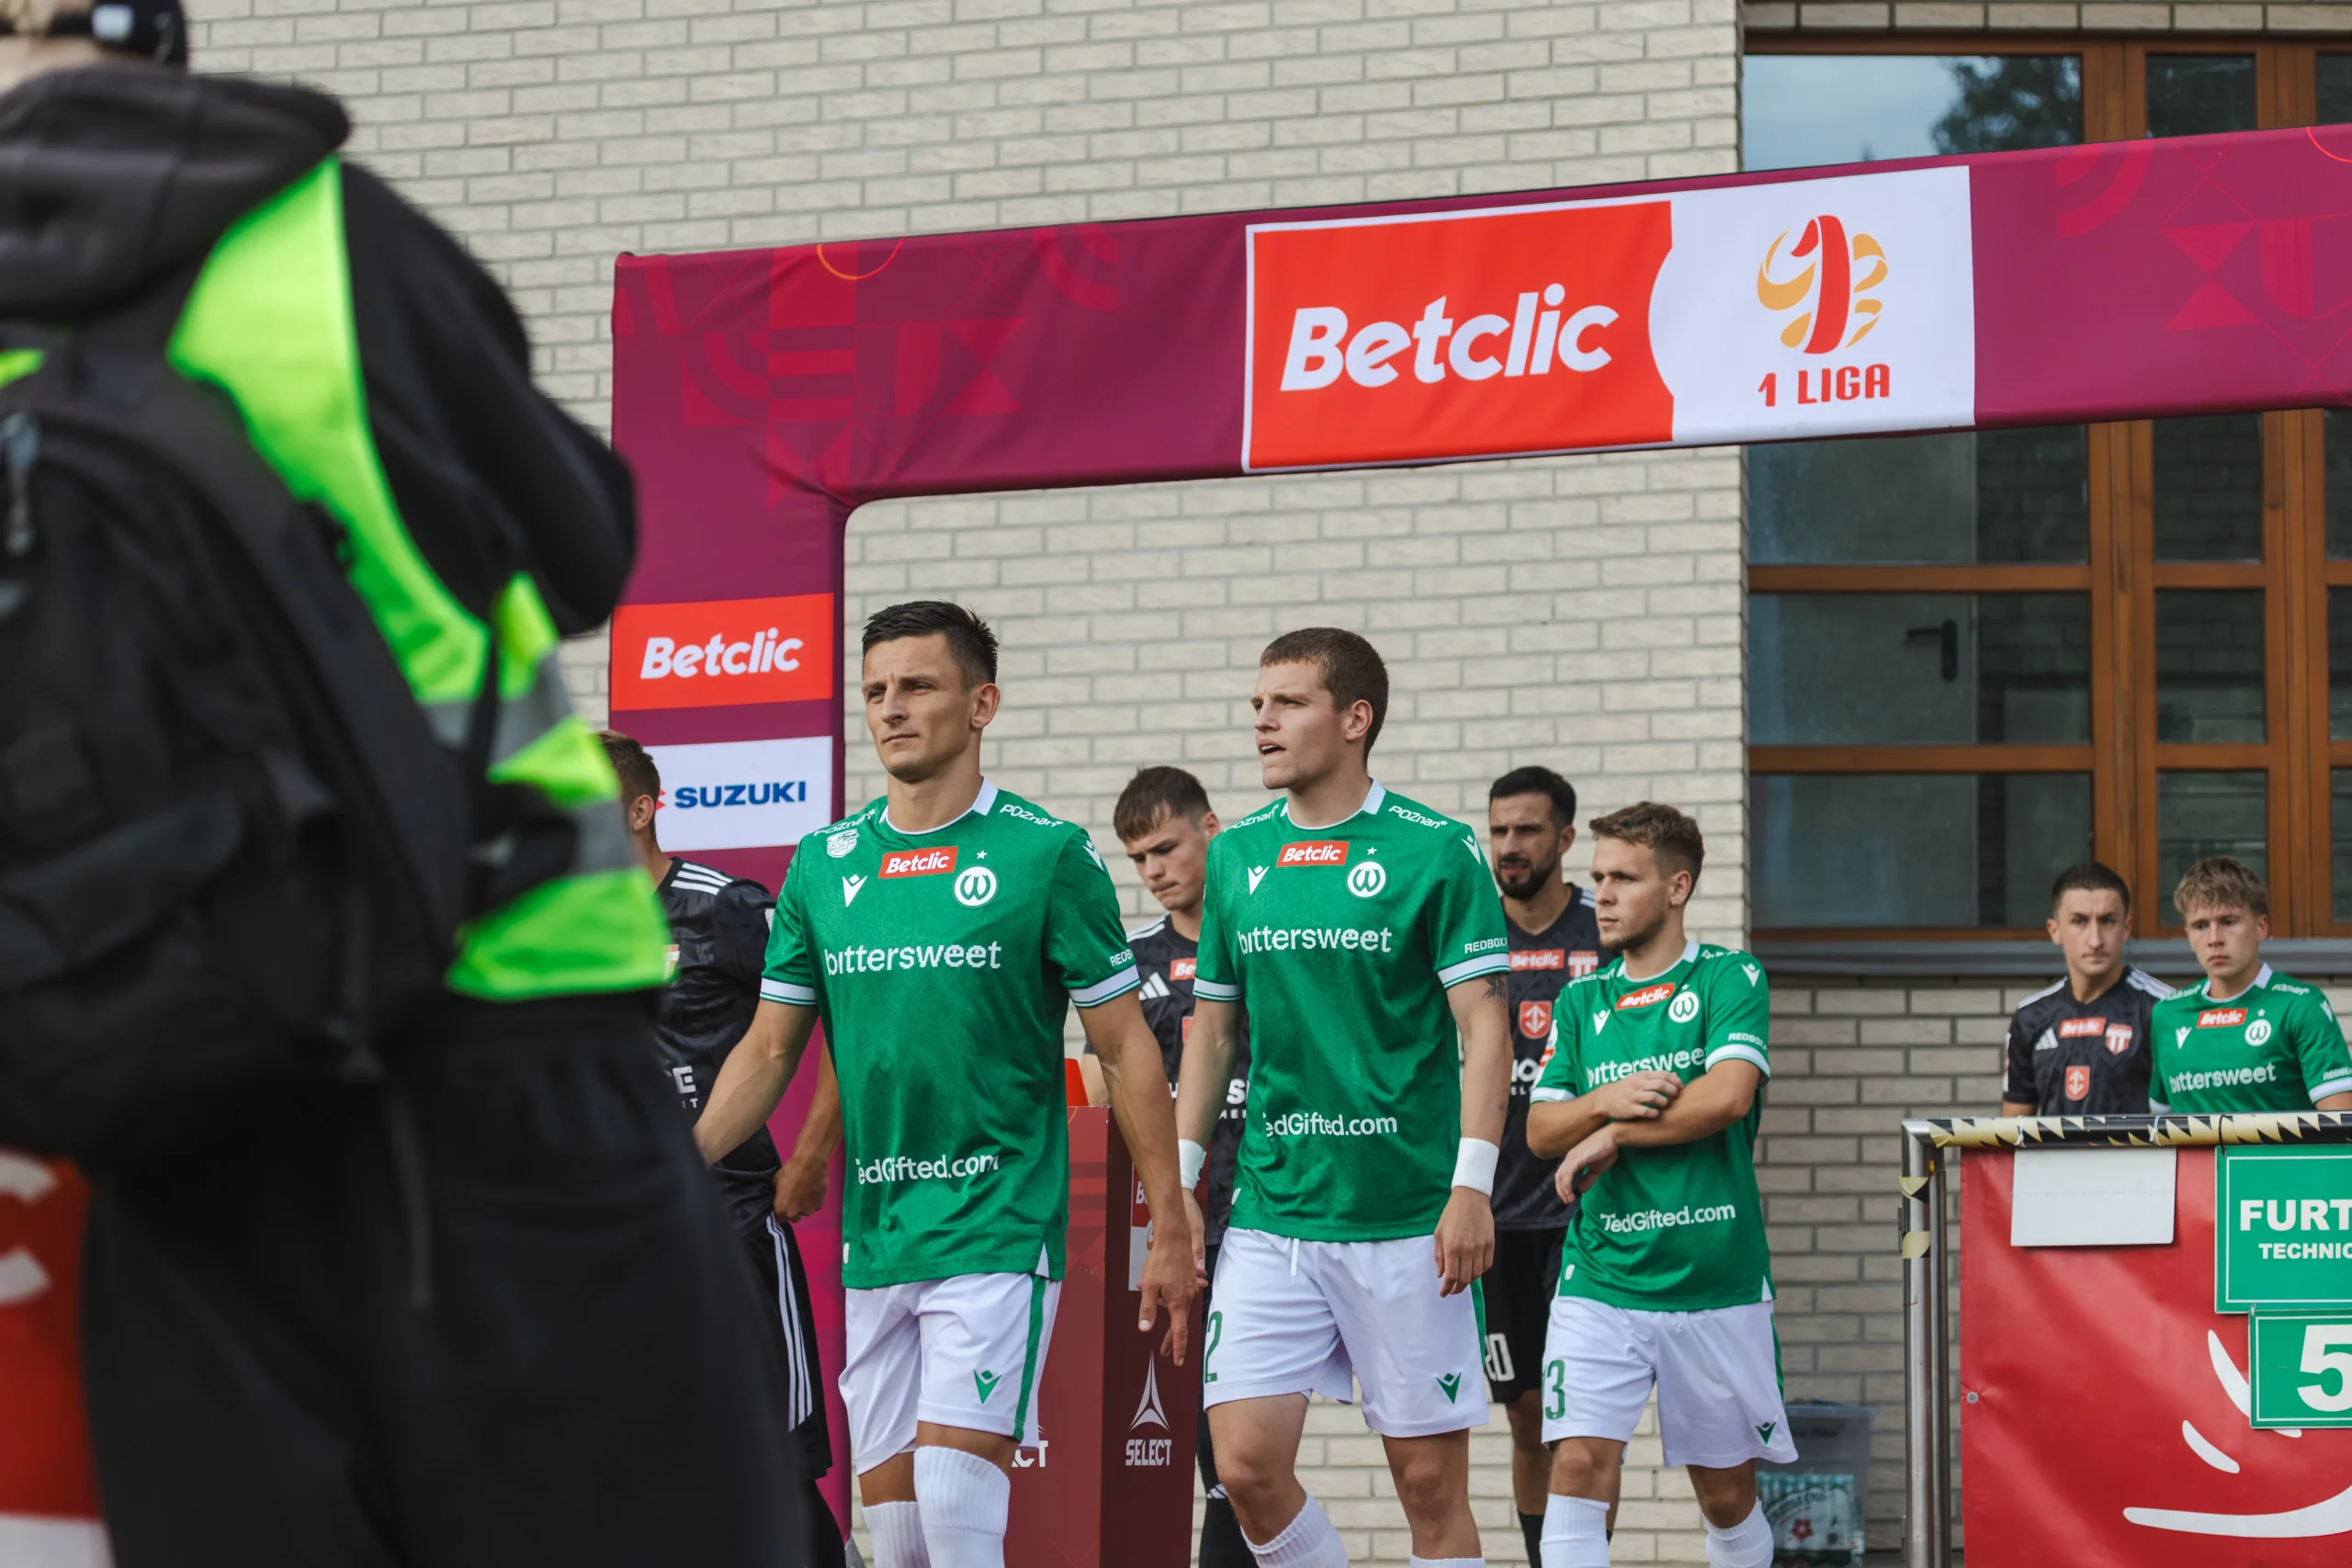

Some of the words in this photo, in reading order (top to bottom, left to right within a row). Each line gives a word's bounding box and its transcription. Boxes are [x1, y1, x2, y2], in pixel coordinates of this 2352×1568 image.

[1280, 283, 1619, 392] Betclic
[1758, 373, 1778, 407] 1
[1797, 364, 1891, 405] LIGA
[640, 627, 804, 679] Betclic
[674, 781, 806, 809] SUZUKI
[886, 852, 950, 874] Betclic
[1283, 844, 1342, 863] Betclic
[1238, 925, 1393, 955] bittersweet
[824, 941, 1002, 976] bittersweet
[1510, 952, 1560, 967] Betclic
[1620, 987, 1670, 1008] Betclic
[1586, 1047, 1707, 1088] bitterswee
[2169, 1062, 2278, 1094] bittersweet
[1262, 1111, 1398, 1138] edGifted.com
[855, 1154, 999, 1185] edGifted.com
[1600, 1204, 1736, 1233] TedGifted.com
[2240, 1199, 2352, 1232] FURT
[2297, 1324, 2352, 1412] 5
[1543, 1359, 1566, 1420] 3
[1125, 1438, 1172, 1466] SELECT
